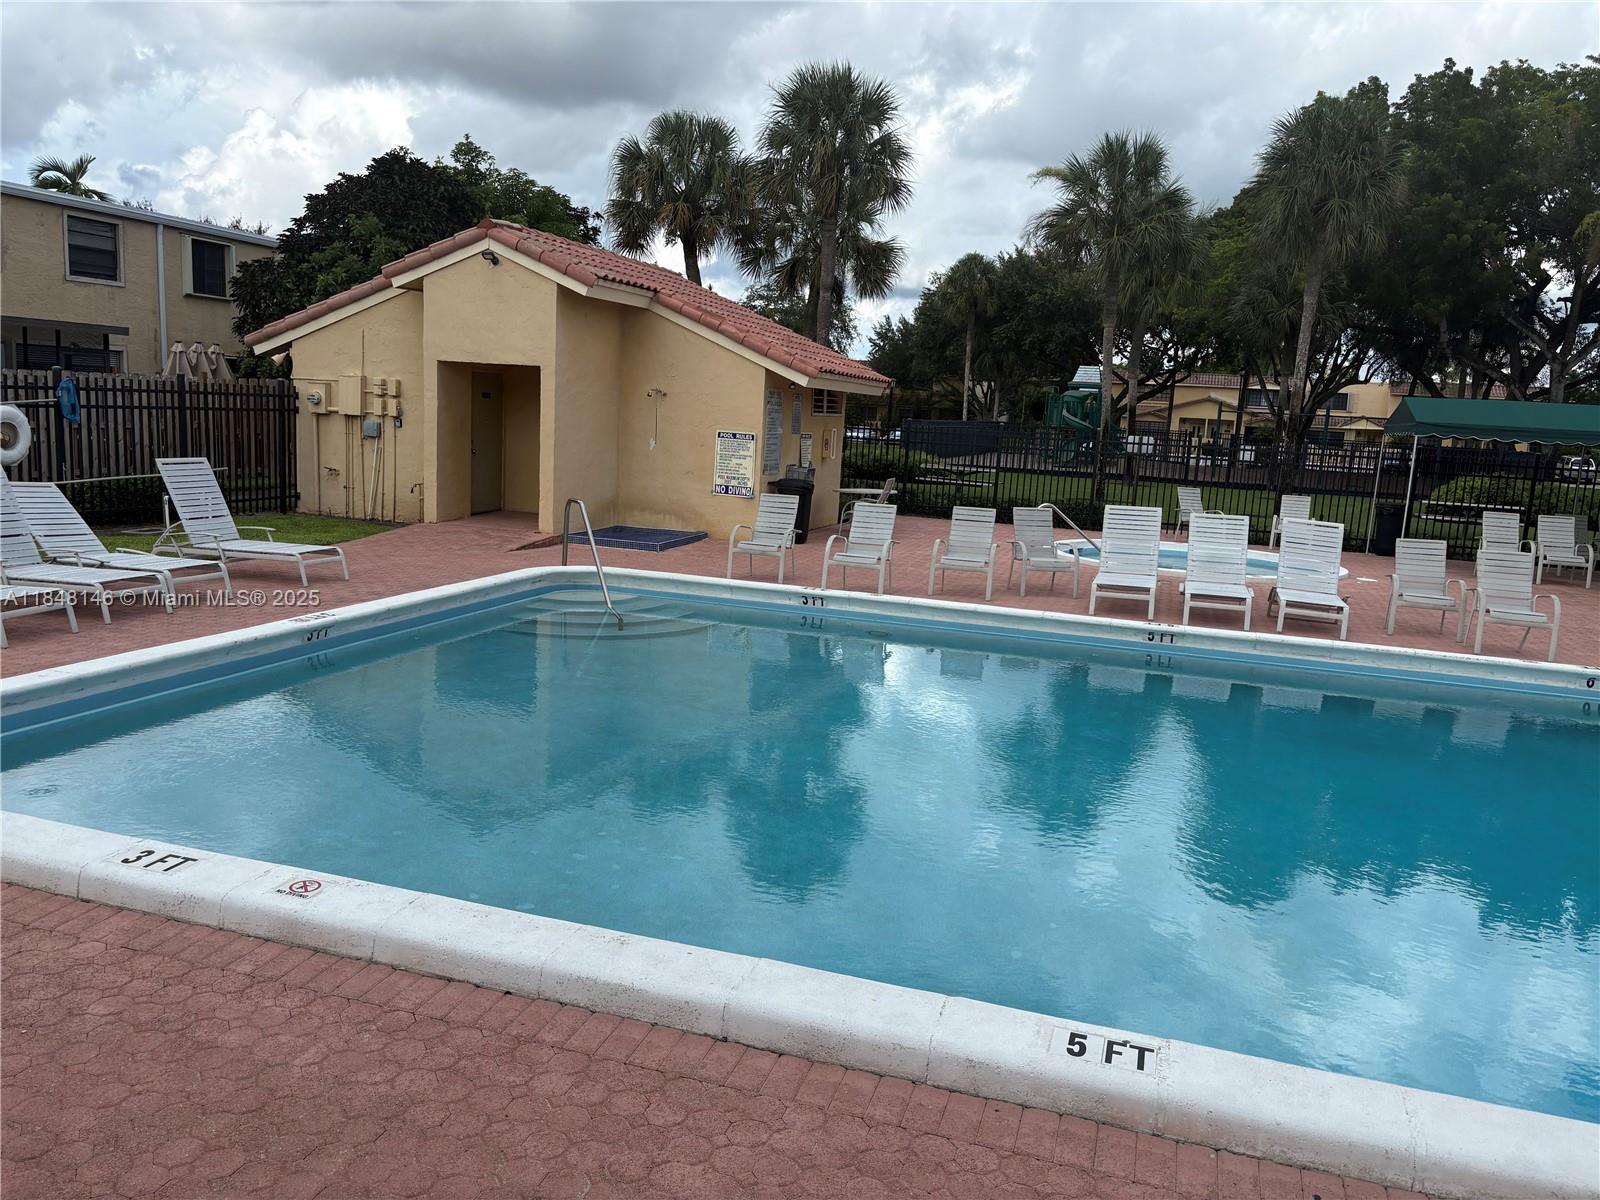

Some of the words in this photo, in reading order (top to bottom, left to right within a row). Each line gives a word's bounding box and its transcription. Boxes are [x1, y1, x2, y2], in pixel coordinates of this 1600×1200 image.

[715, 485, 726, 494] NO
[728, 486, 751, 496] DIVING
[801, 595, 809, 606] 3
[812, 596, 824, 607] FT
[1147, 631, 1155, 642] 5
[1160, 633, 1176, 644] FT
[1586, 677, 1597, 689] 6
[121, 850, 156, 864] 3
[143, 854, 199, 872] FT
[1066, 1032, 1088, 1057] 5
[1104, 1039, 1155, 1071] FT
